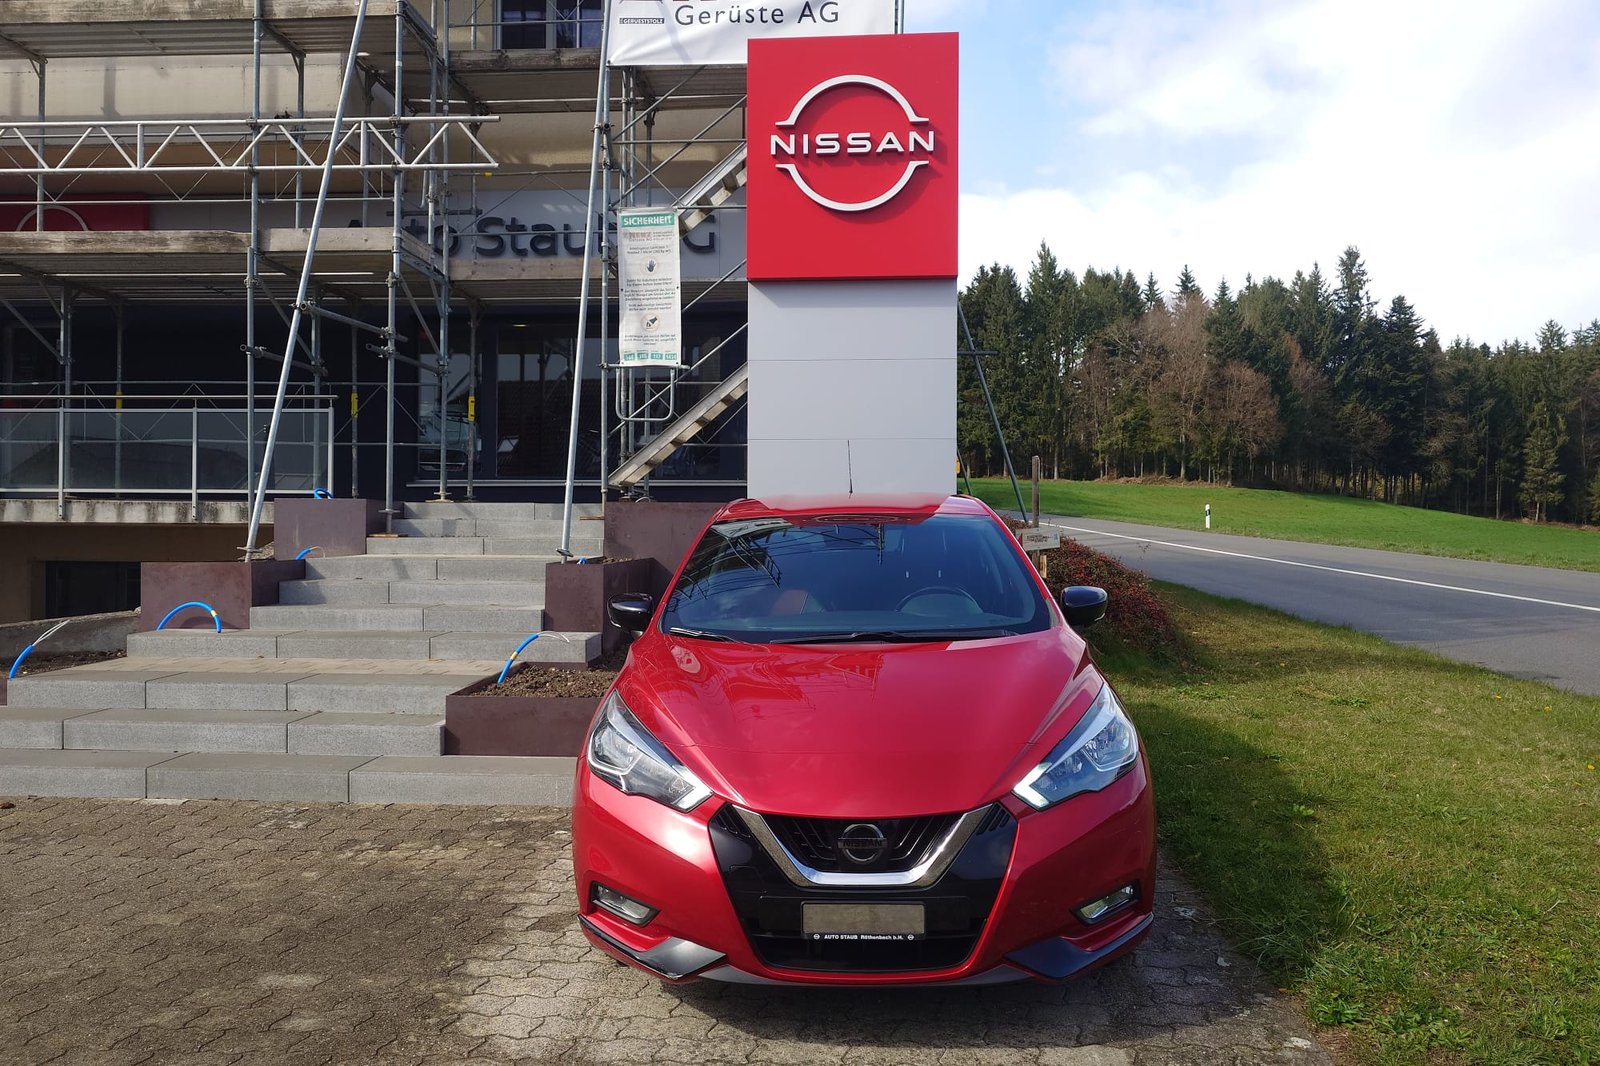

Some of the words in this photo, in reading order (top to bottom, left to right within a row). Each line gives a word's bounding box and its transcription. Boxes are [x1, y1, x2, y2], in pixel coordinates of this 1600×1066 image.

[674, 4, 784, 26] Gerüste
[797, 1, 839, 24] AG
[770, 131, 935, 155] NISSAN
[623, 215, 673, 226] SICHERHEIT
